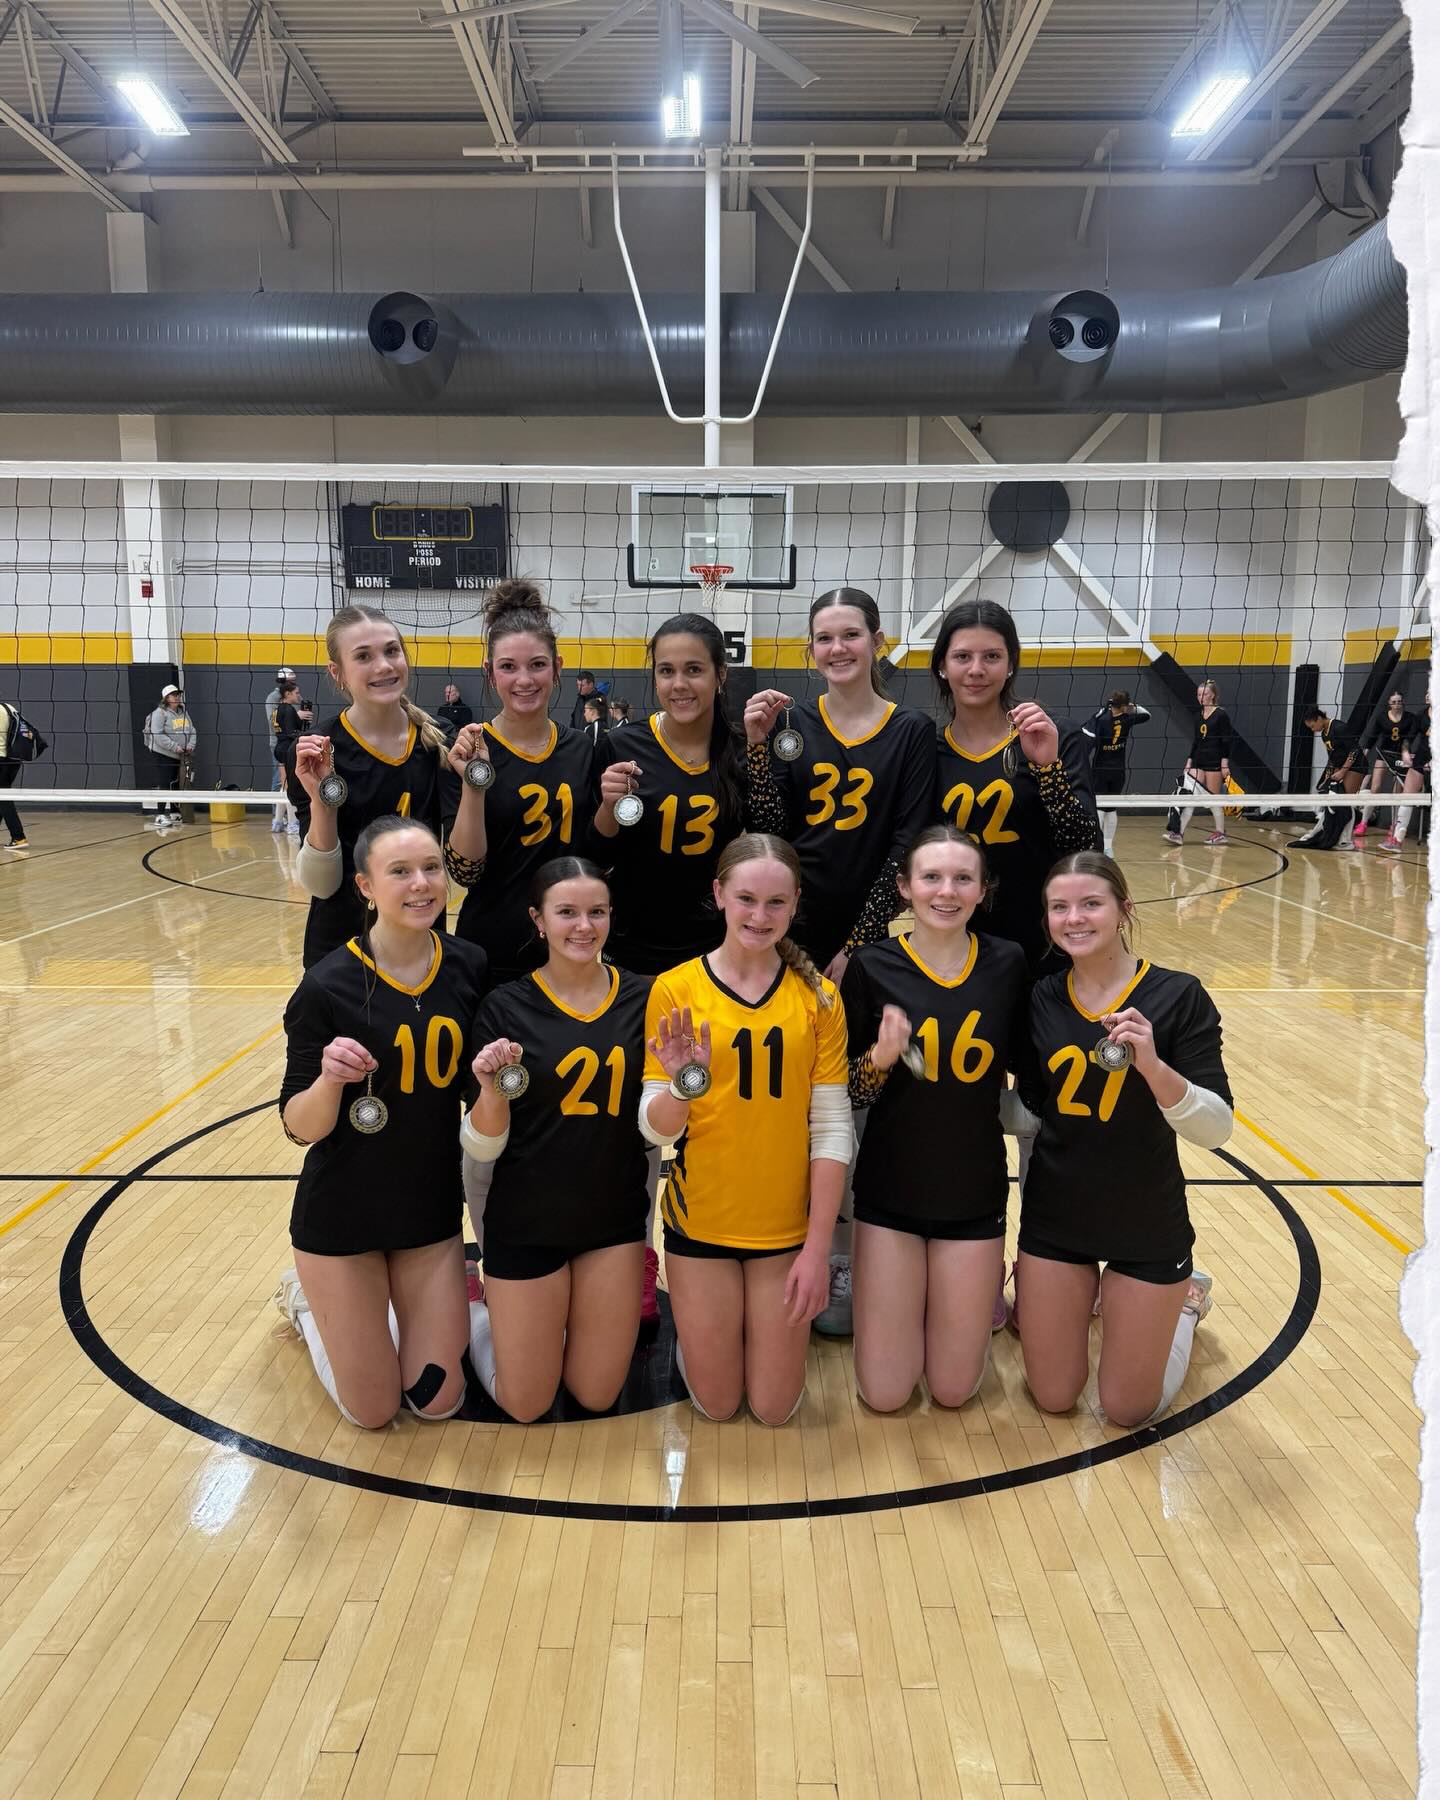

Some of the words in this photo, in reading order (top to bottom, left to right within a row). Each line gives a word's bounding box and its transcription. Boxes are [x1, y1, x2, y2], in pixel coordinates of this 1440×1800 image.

[355, 576, 391, 588] HOME
[409, 556, 441, 566] PERIOD
[1391, 727, 1400, 741] 8
[518, 783, 573, 847] 31
[658, 794, 718, 855] 13
[806, 762, 874, 831] 33
[942, 778, 1020, 845] 22
[394, 1015, 463, 1094] 10
[555, 1045, 625, 1116] 21
[731, 1026, 783, 1100] 11
[917, 1010, 994, 1083] 16
[1048, 1044, 1127, 1122] 27
